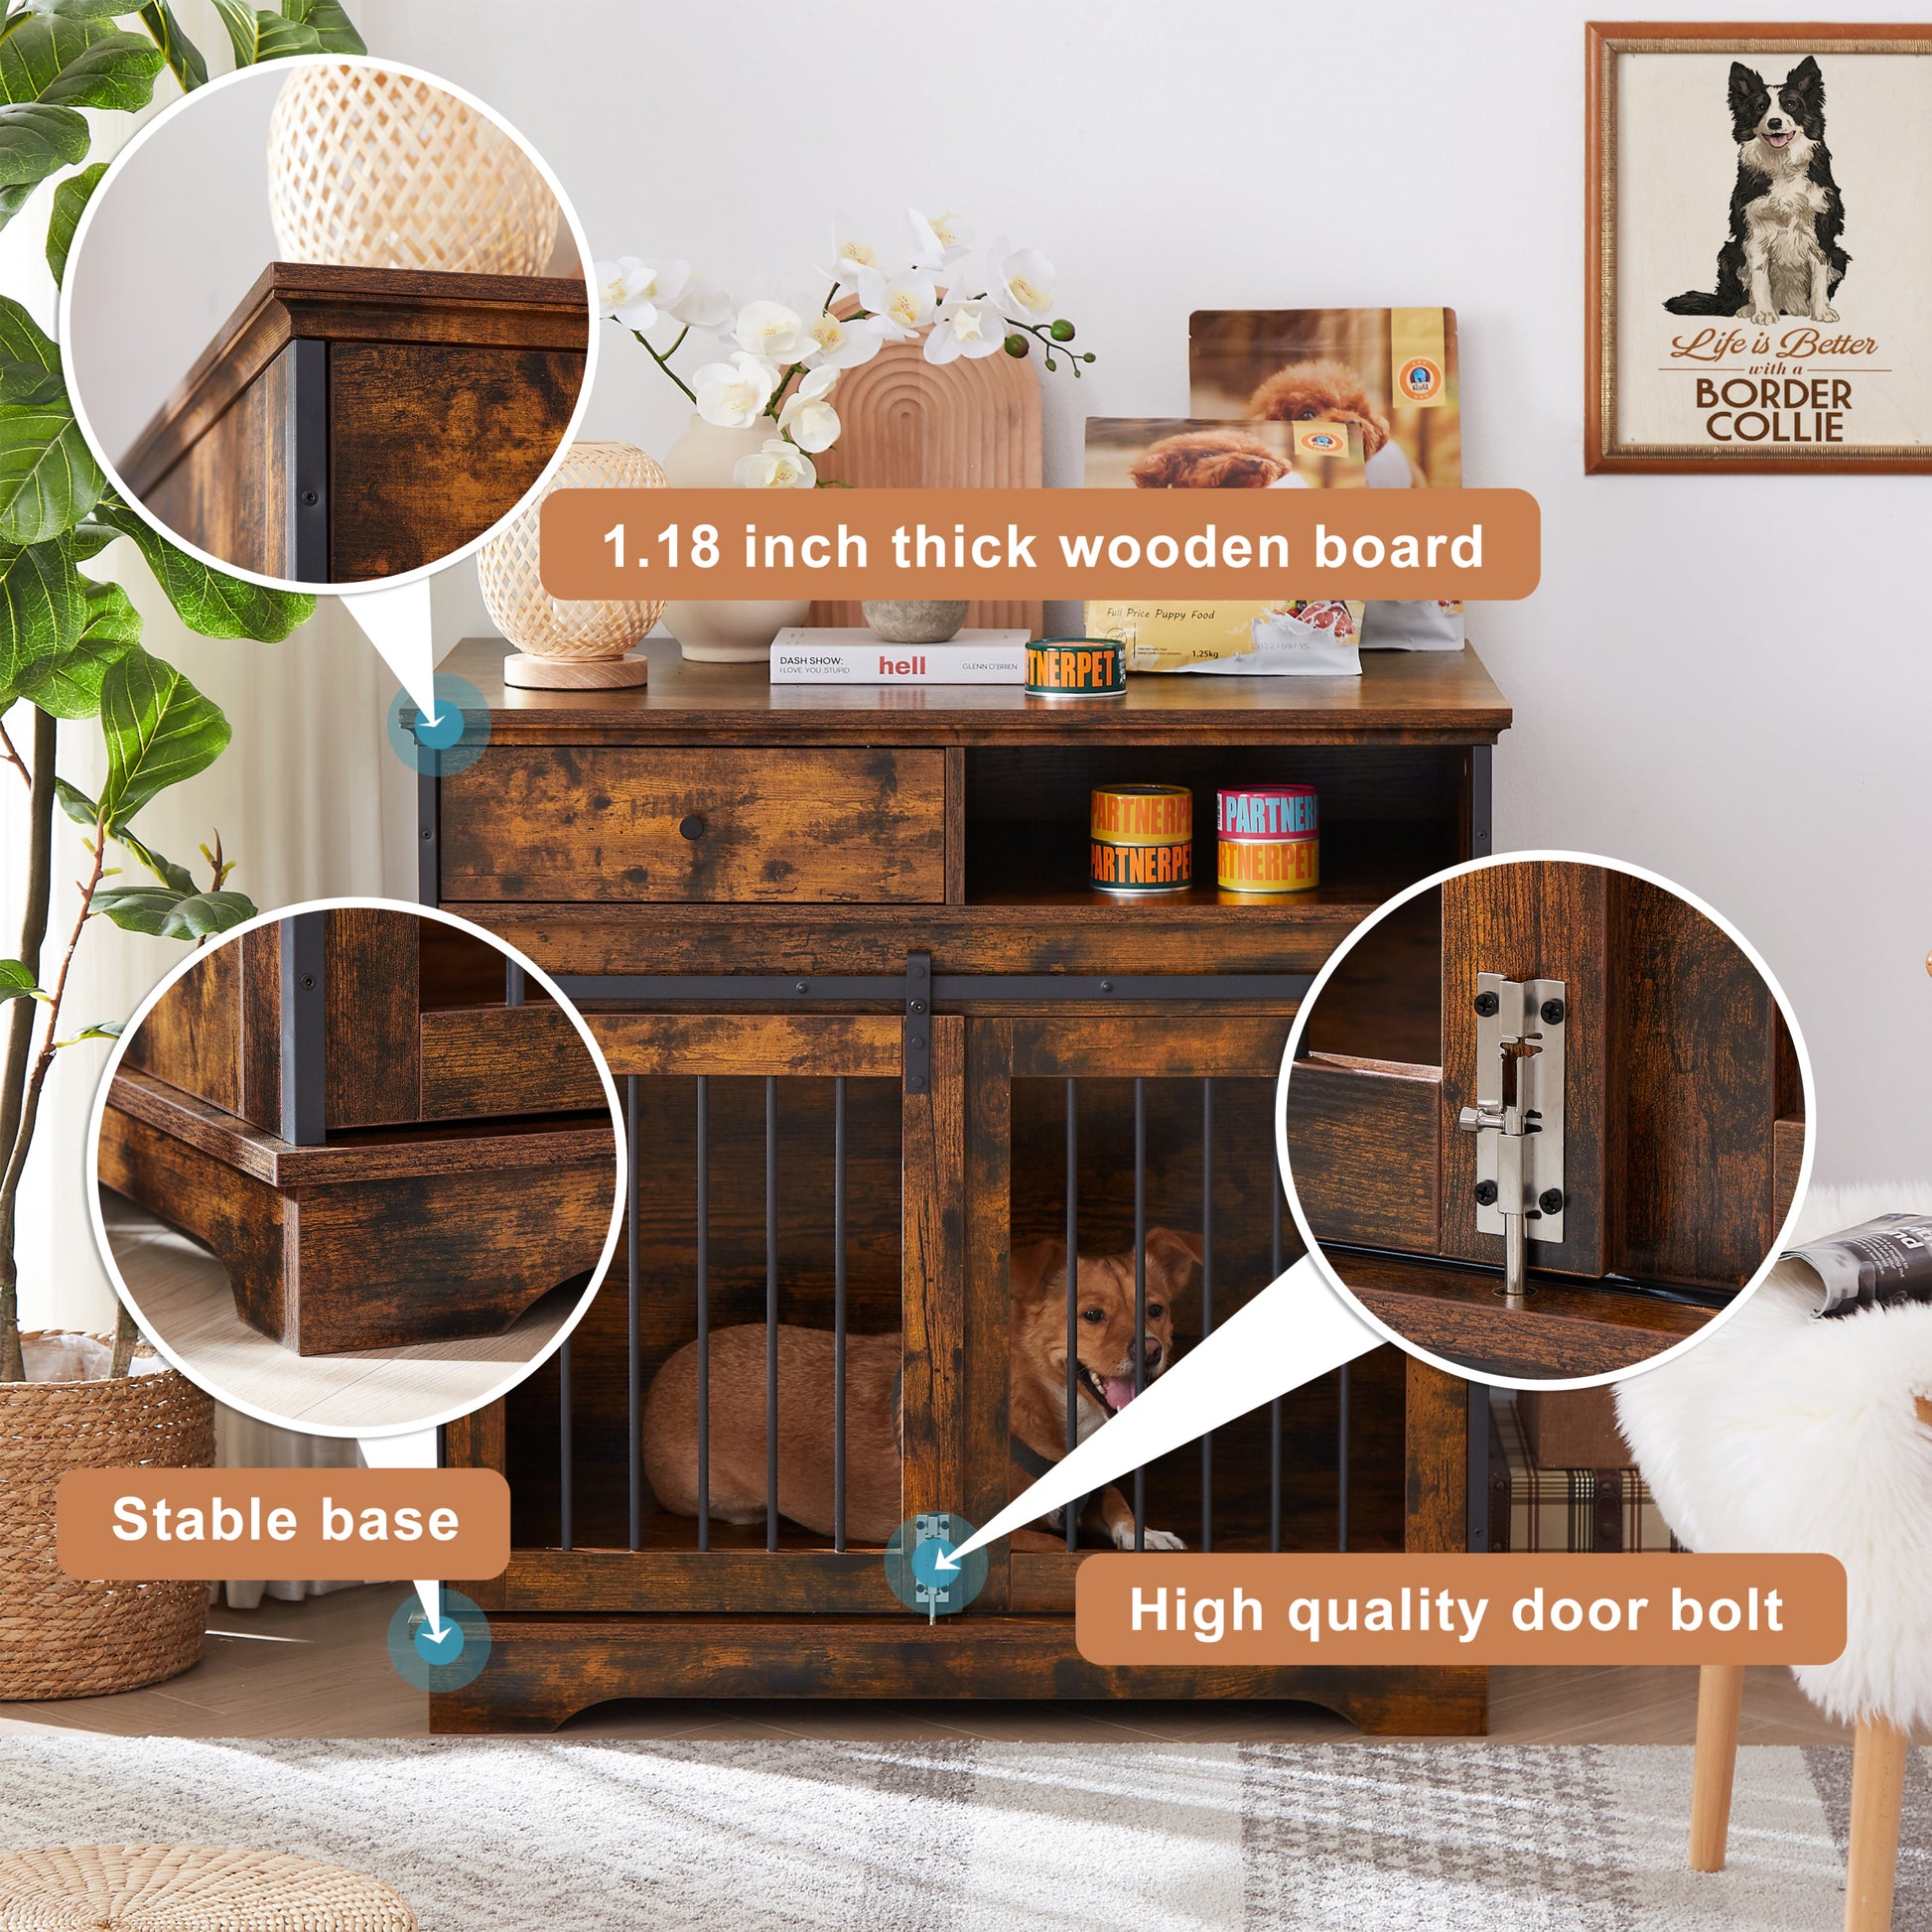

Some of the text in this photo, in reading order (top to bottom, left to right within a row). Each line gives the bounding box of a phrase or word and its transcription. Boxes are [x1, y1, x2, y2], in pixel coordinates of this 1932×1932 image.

[1670, 328, 1879, 362] Life is Better
[1748, 362, 1803, 375] with a
[1696, 377, 1853, 410] BORDER
[1706, 411, 1844, 442] COLLIE
[1107, 608, 1216, 621] Full Price Puppy Food
[779, 656, 844, 665] DASH SHOW:
[1191, 650, 1219, 659] 1.25kg
[879, 655, 926, 675] hell
